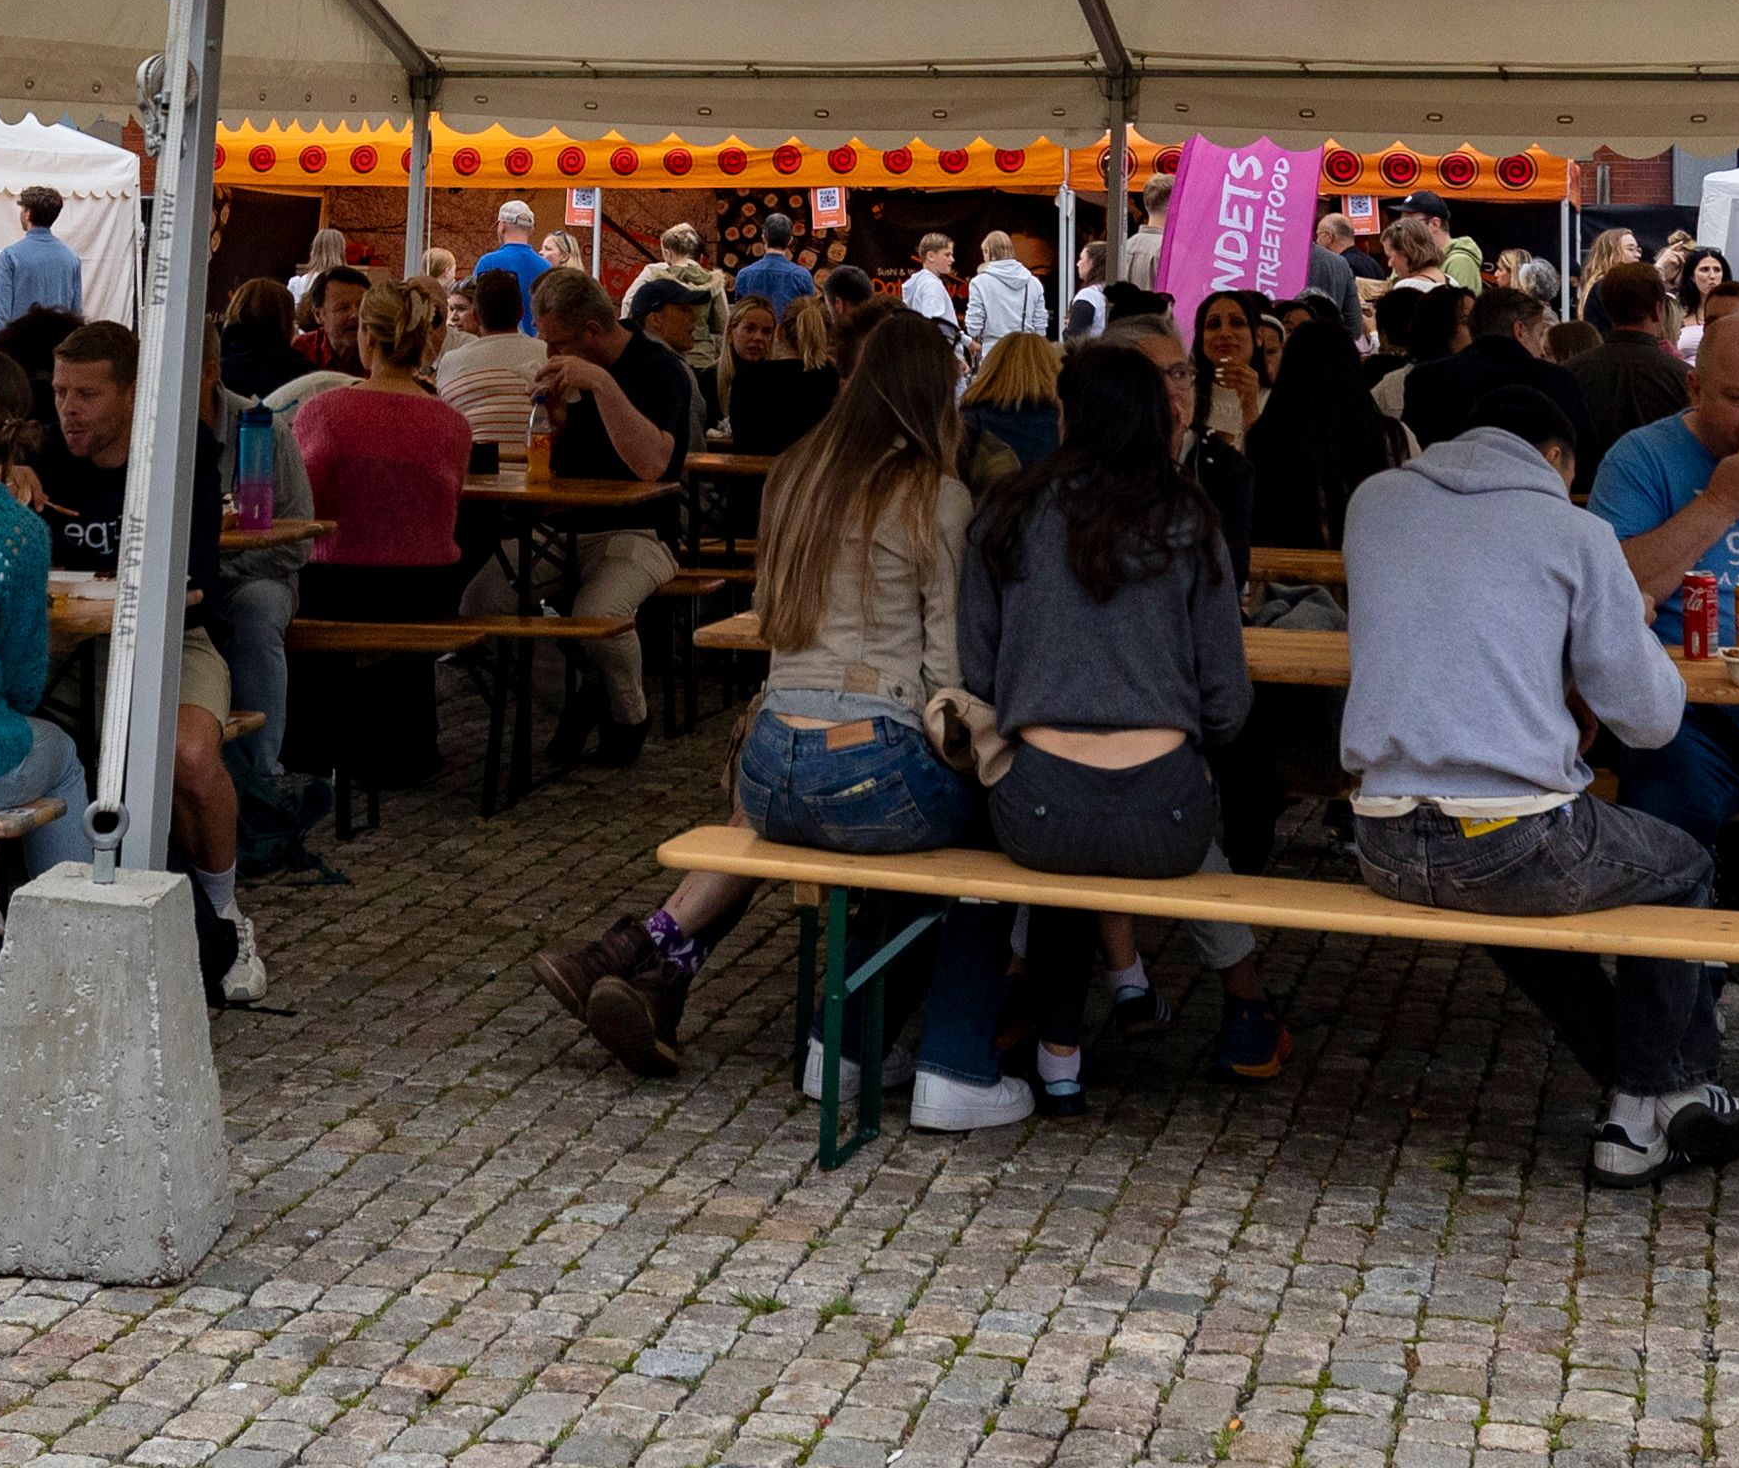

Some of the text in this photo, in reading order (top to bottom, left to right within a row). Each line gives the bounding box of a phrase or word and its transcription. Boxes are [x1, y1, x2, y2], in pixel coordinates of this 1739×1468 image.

[152, 188, 175, 306] JALLA JALLA
[1210, 152, 1264, 292] NDETS
